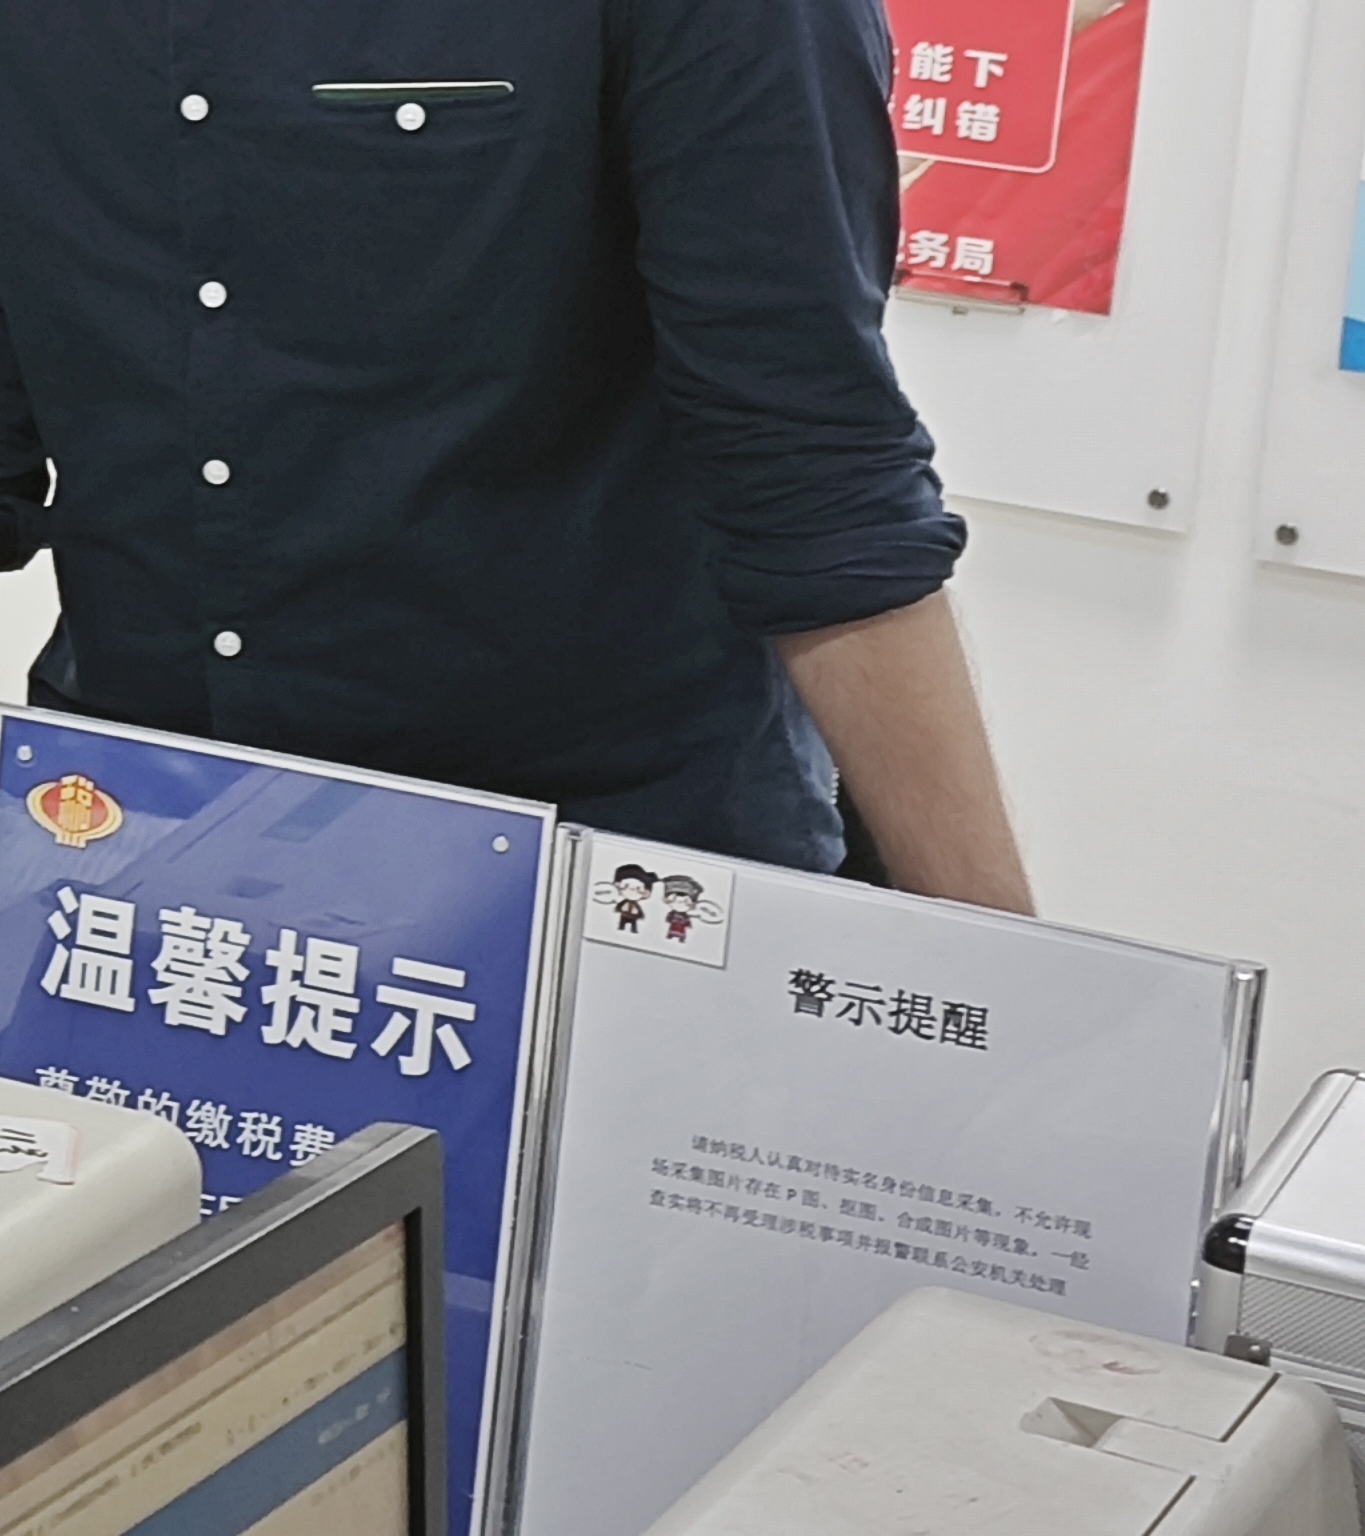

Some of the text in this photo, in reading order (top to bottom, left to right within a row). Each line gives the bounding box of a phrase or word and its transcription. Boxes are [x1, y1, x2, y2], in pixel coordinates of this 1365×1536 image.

[893, 41, 1009, 88] 能下
[887, 94, 1000, 142] 纠错
[897, 229, 995, 275] 务局
[41, 884, 477, 1077] 温馨提示
[788, 967, 990, 1051] 警示提醒
